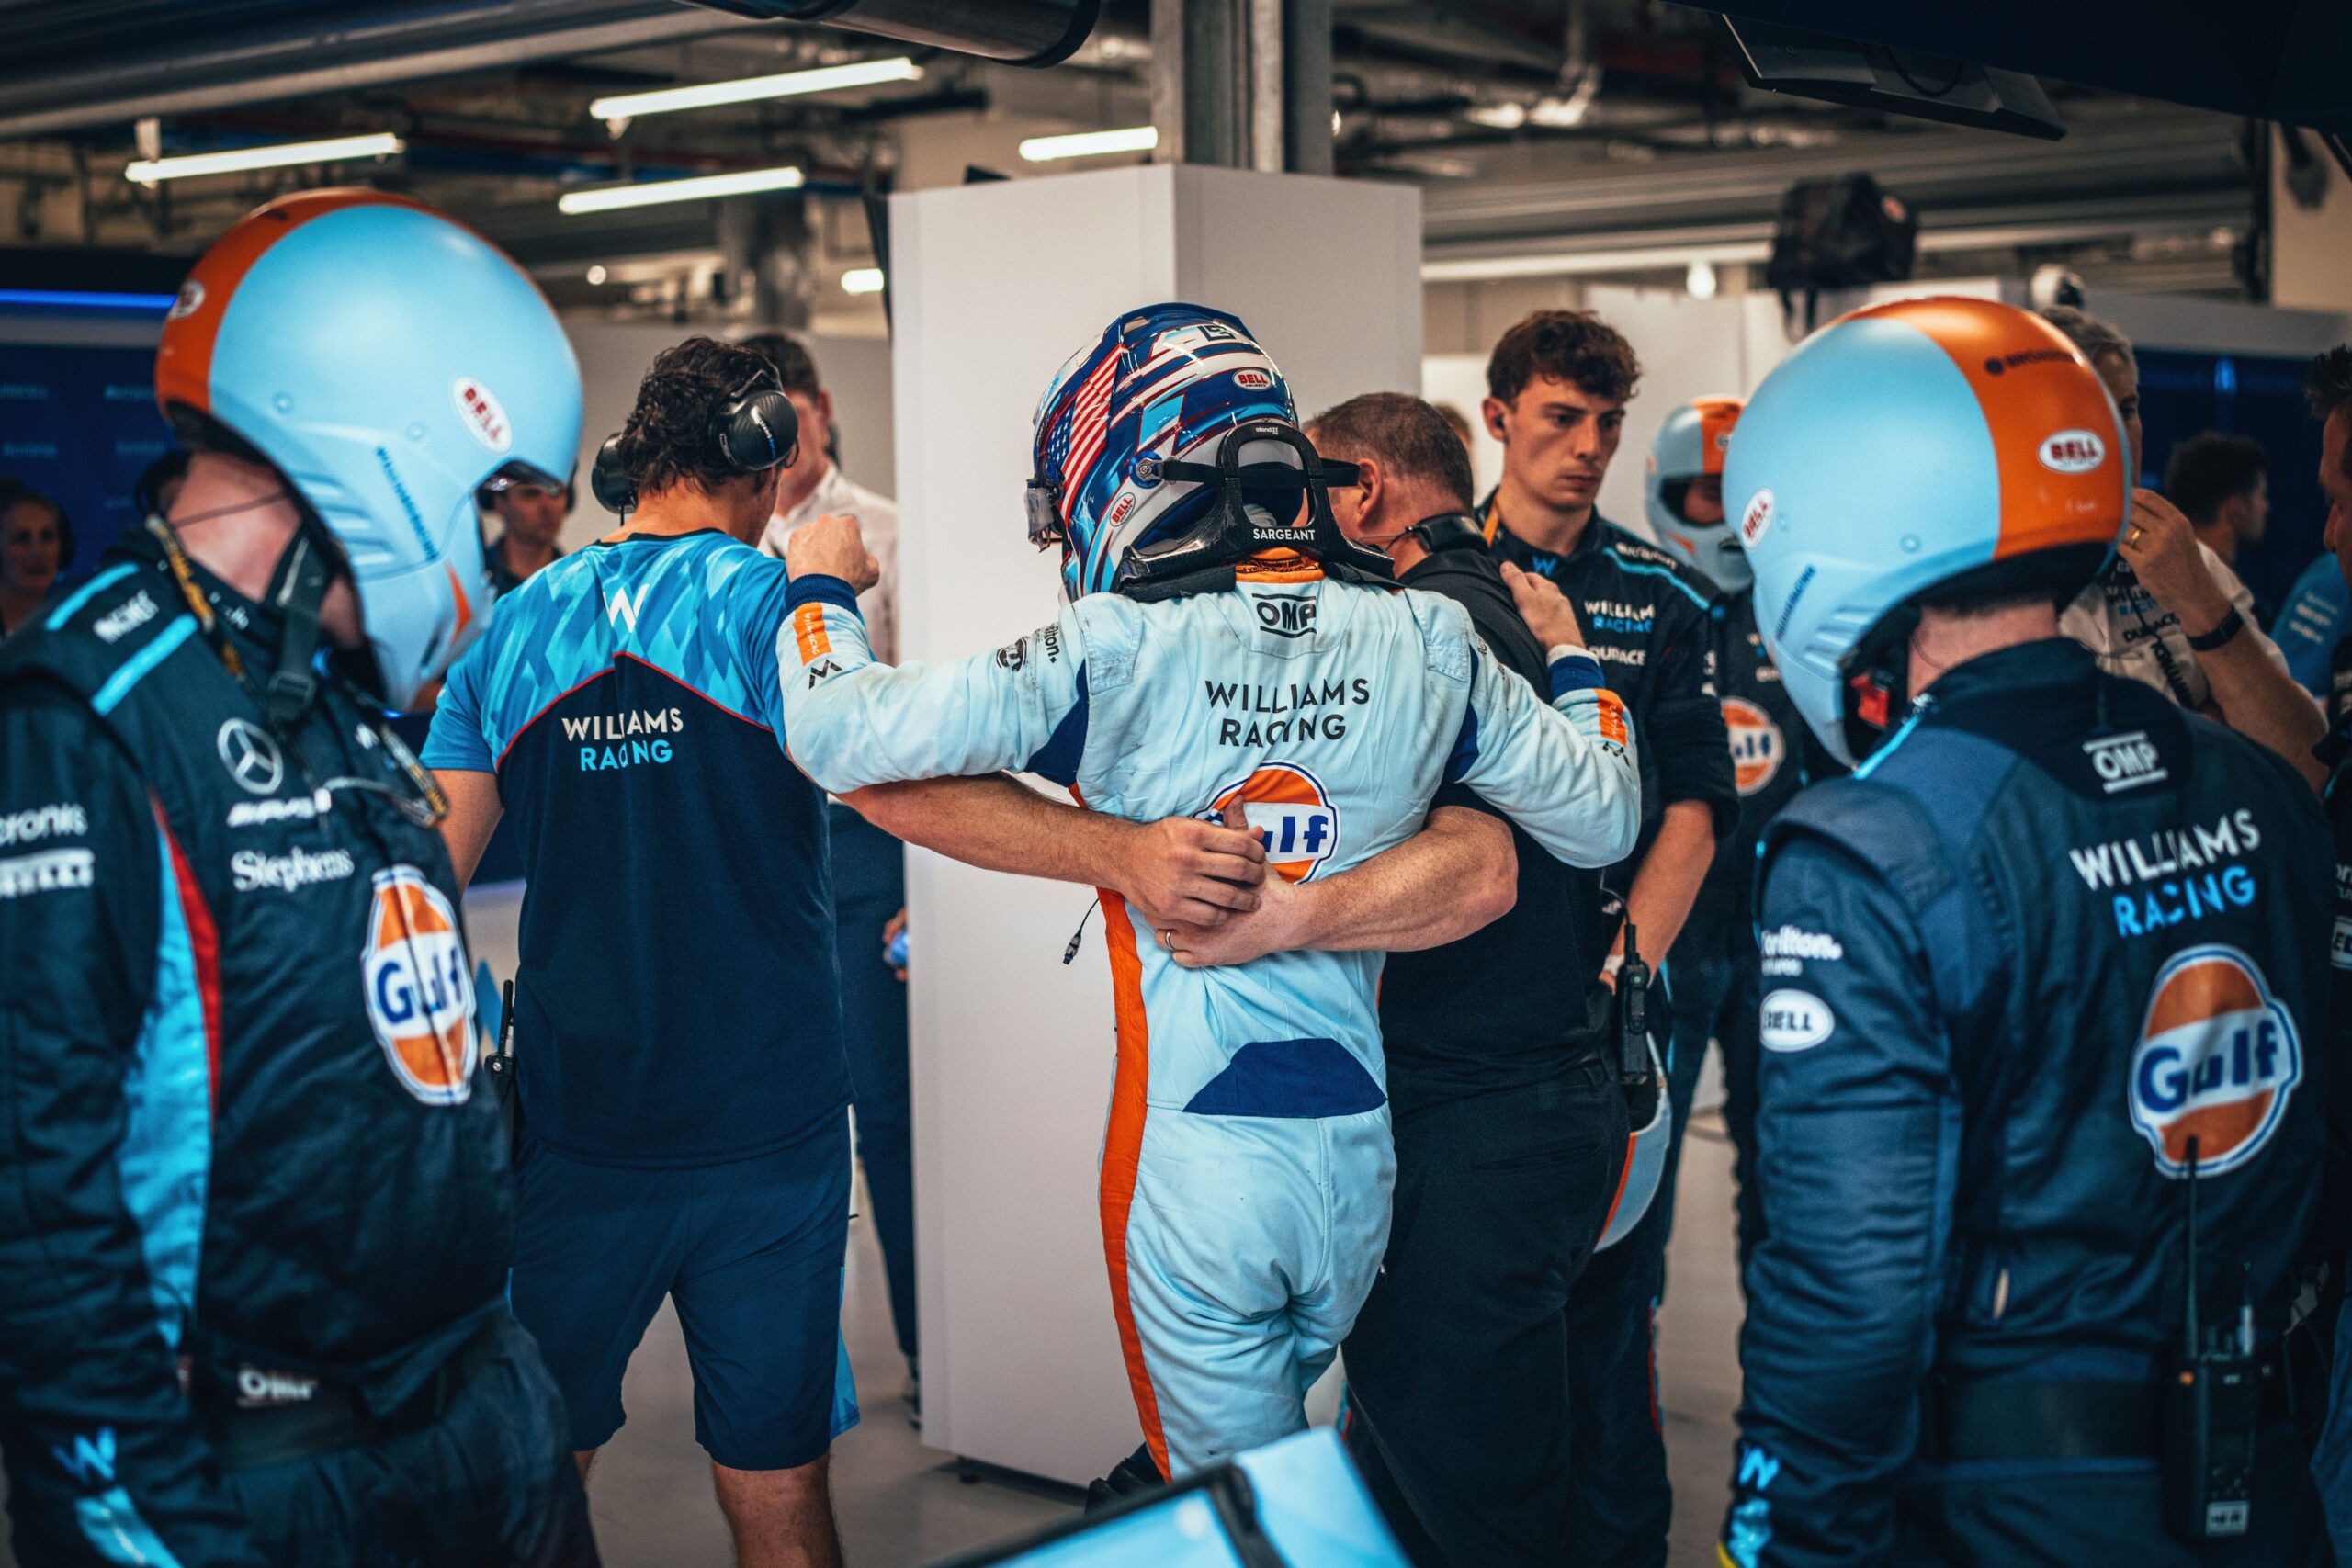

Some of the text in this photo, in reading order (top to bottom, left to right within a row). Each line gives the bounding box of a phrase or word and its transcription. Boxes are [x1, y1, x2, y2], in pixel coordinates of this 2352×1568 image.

[1237, 374, 1269, 385] BELL
[463, 387, 503, 443] BELL
[2050, 438, 2098, 461] BELL
[1111, 498, 1134, 525] BELL
[1252, 528, 1316, 541] SARGEANT
[1256, 600, 1317, 631] OMP
[1584, 599, 1656, 622] WILLIAM
[1204, 678, 1370, 714] WILLIAMS
[561, 707, 684, 742] WILIAMS
[1218, 714, 1347, 748] RACING
[2092, 741, 2160, 782] OMP
[2068, 807, 2262, 892] WILLIAMS
[230, 845, 356, 894] Stephens
[2112, 864, 2256, 938] RACING
[2138, 1018, 2282, 1114] Gulf
